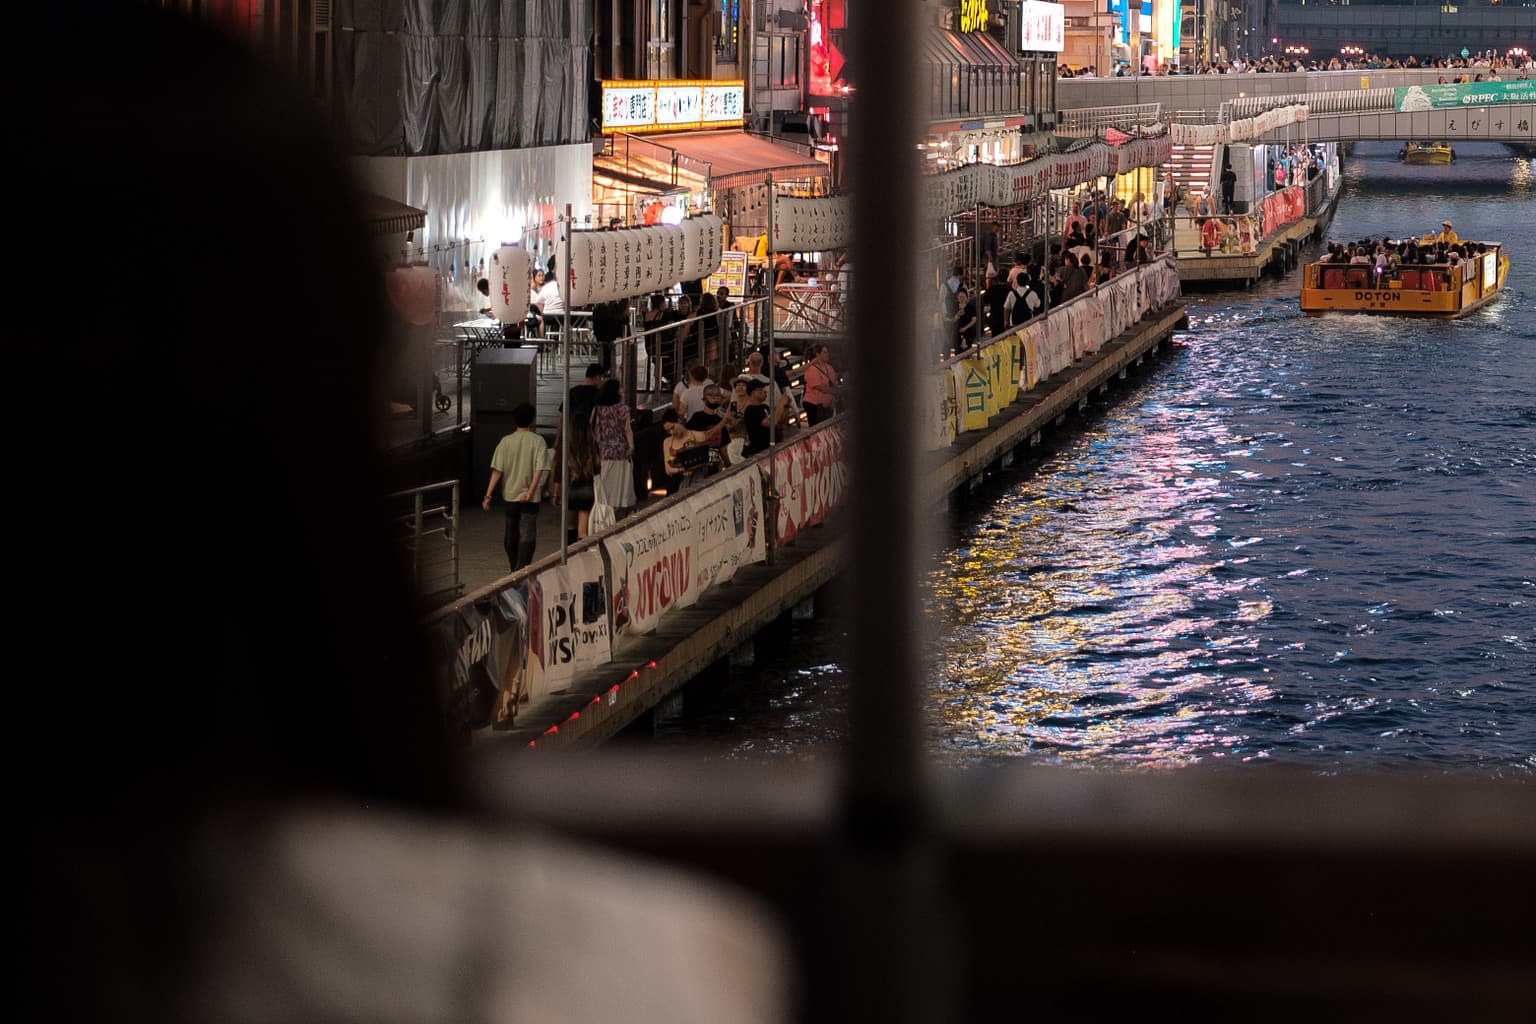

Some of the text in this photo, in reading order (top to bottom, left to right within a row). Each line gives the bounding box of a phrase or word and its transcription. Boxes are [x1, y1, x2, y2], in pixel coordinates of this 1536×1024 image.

[1447, 118, 1529, 132] えびす橋
[1354, 291, 1400, 302] DOTON
